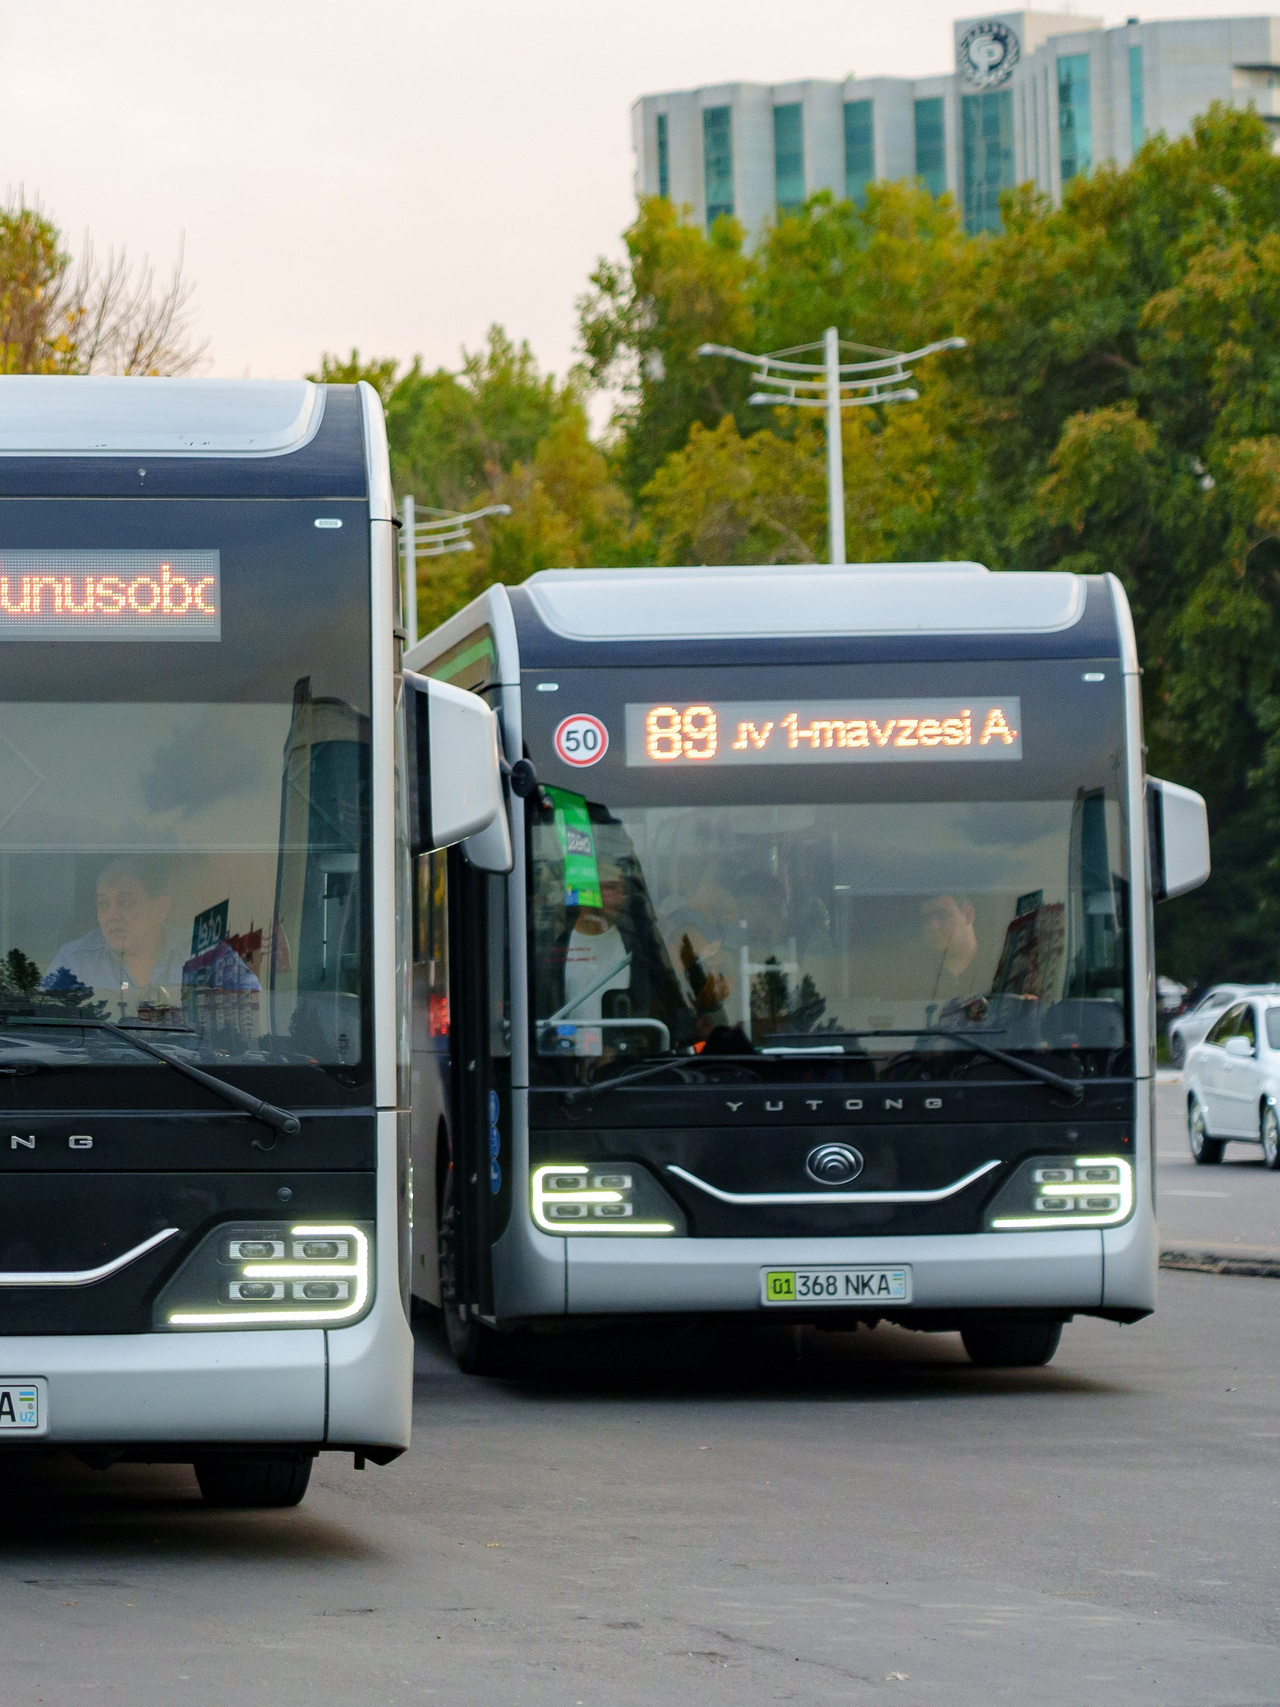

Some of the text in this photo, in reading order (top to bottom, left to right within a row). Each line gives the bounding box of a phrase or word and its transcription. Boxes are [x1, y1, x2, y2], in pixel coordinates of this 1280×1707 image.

[565, 729, 598, 752] 50
[646, 706, 717, 760] 89
[726, 1098, 943, 1112] YUTONG
[772, 1274, 891, 1296] 01 368 NKA
[20, 1411, 35, 1423] UZ
